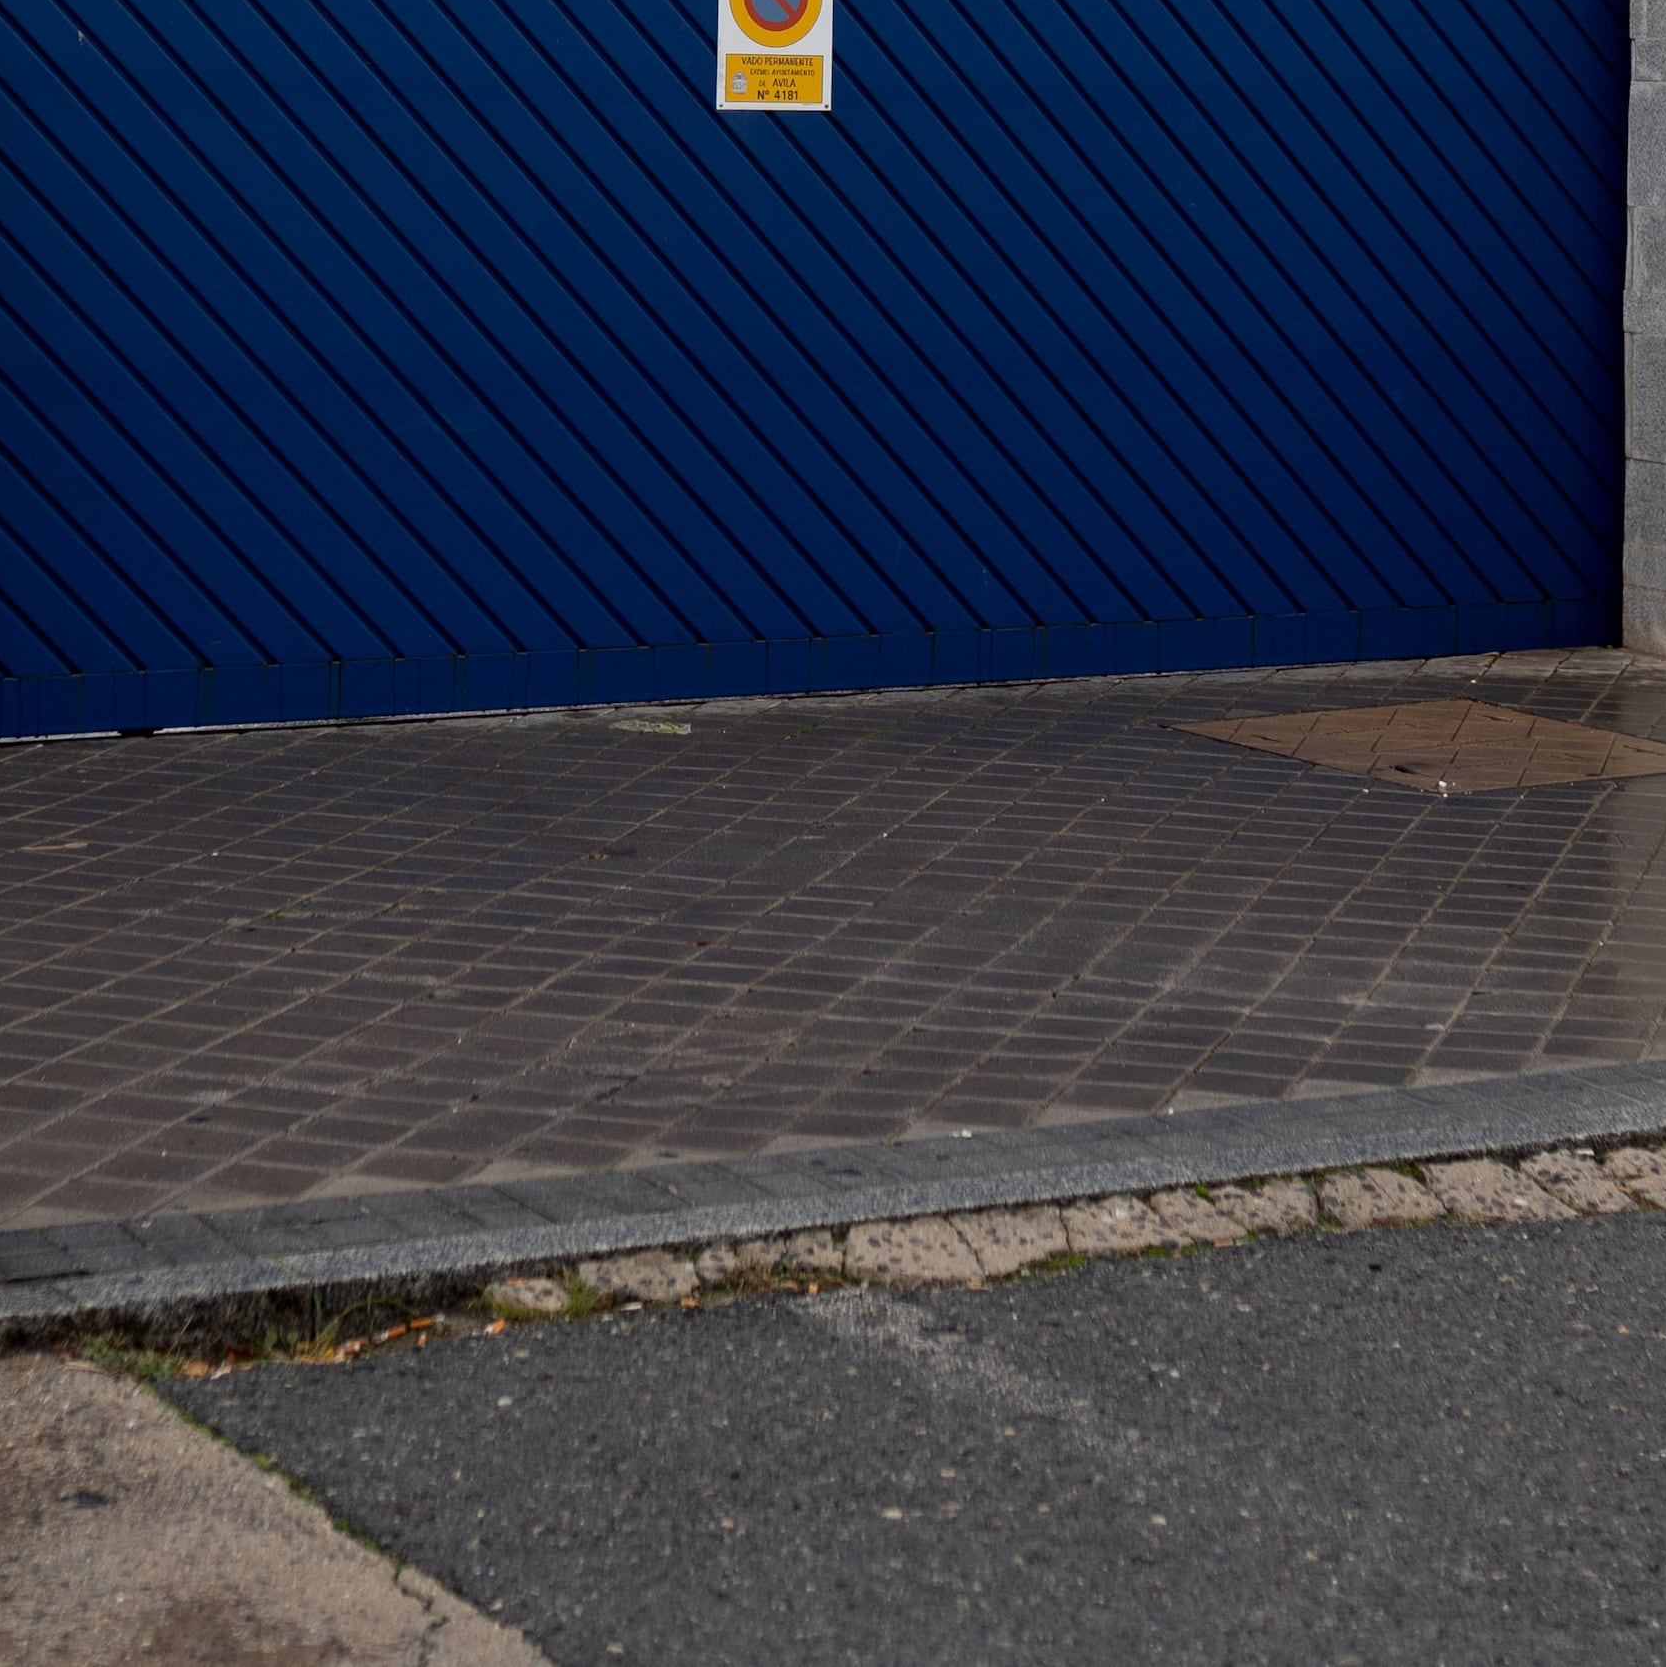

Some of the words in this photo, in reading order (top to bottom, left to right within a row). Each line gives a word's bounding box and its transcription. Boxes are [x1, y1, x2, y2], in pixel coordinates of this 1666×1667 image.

[741, 56, 763, 65] VADO
[764, 56, 814, 67] PERMANENTE
[771, 69, 815, 77] AYUNTAMIENTO
[774, 90, 799, 100] 4181
